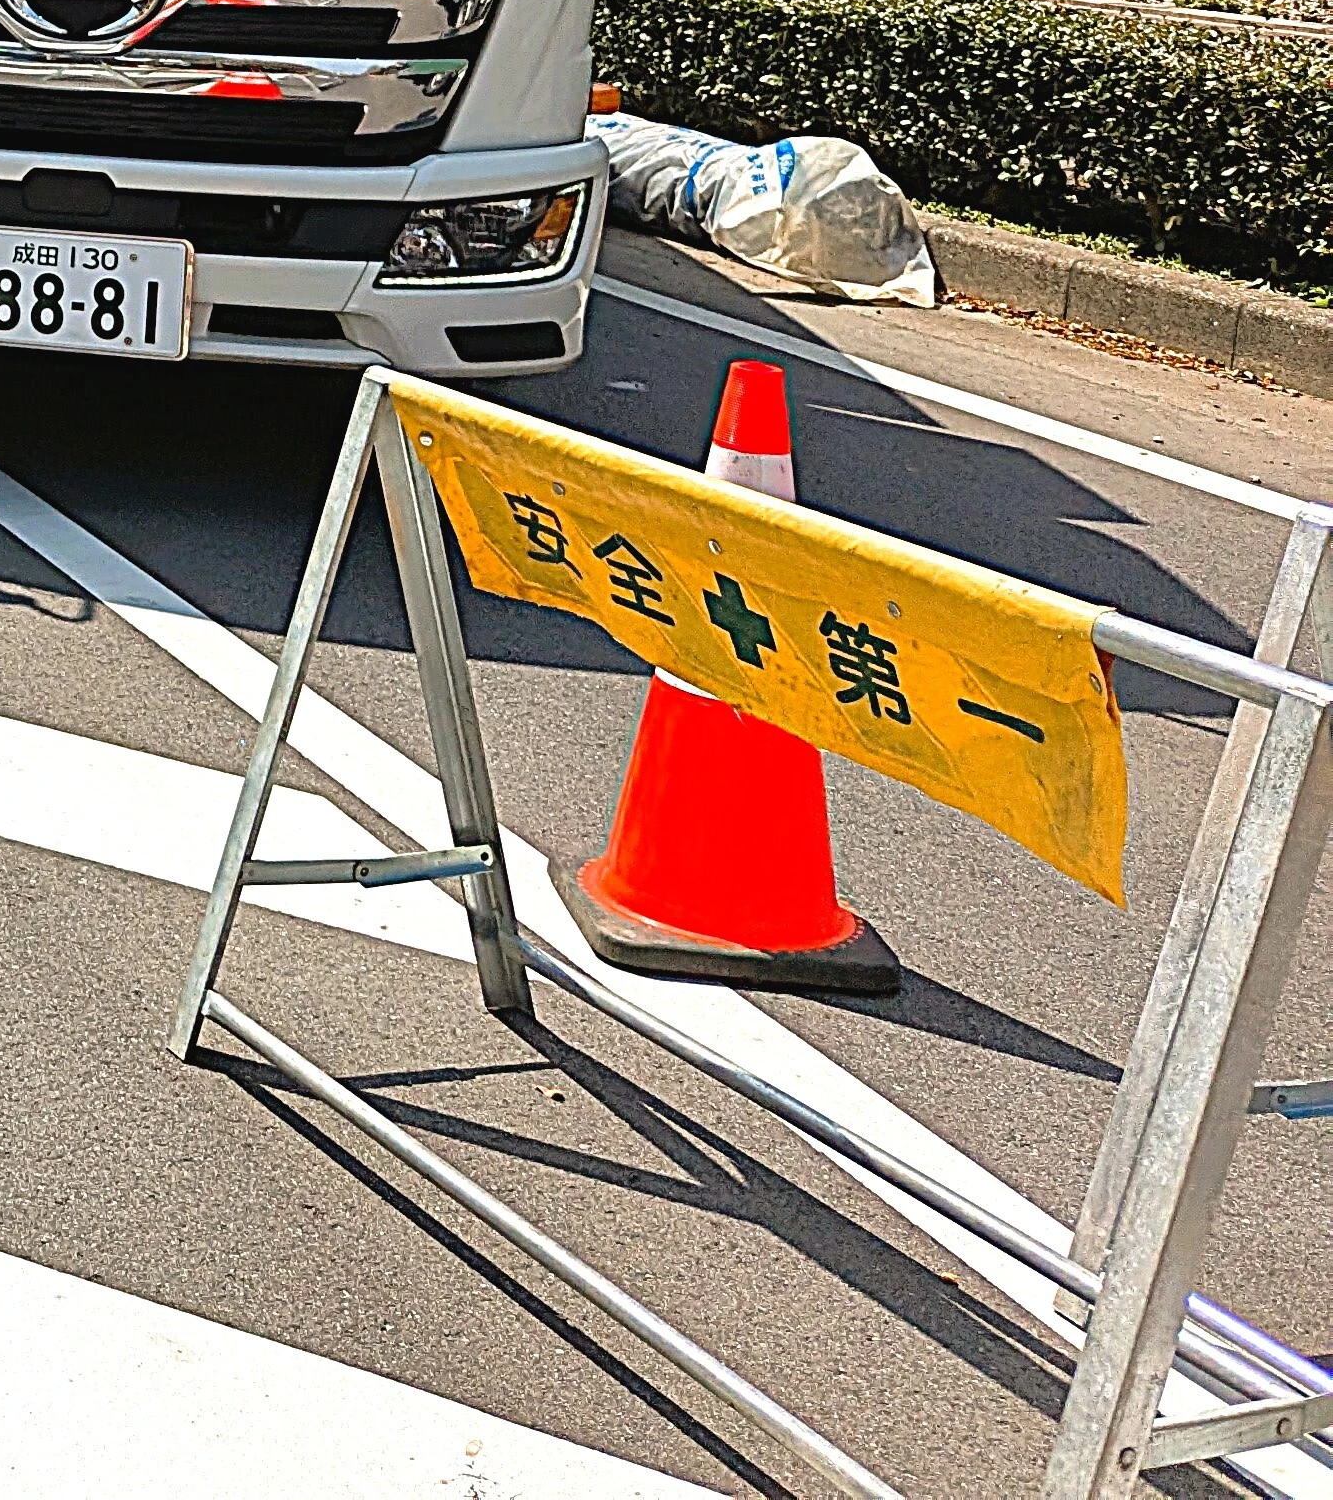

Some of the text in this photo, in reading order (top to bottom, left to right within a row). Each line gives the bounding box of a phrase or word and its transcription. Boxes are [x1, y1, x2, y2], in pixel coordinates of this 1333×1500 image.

[12, 243, 120, 271] 成田 130
[502, 490, 1046, 743] 安全 第一
